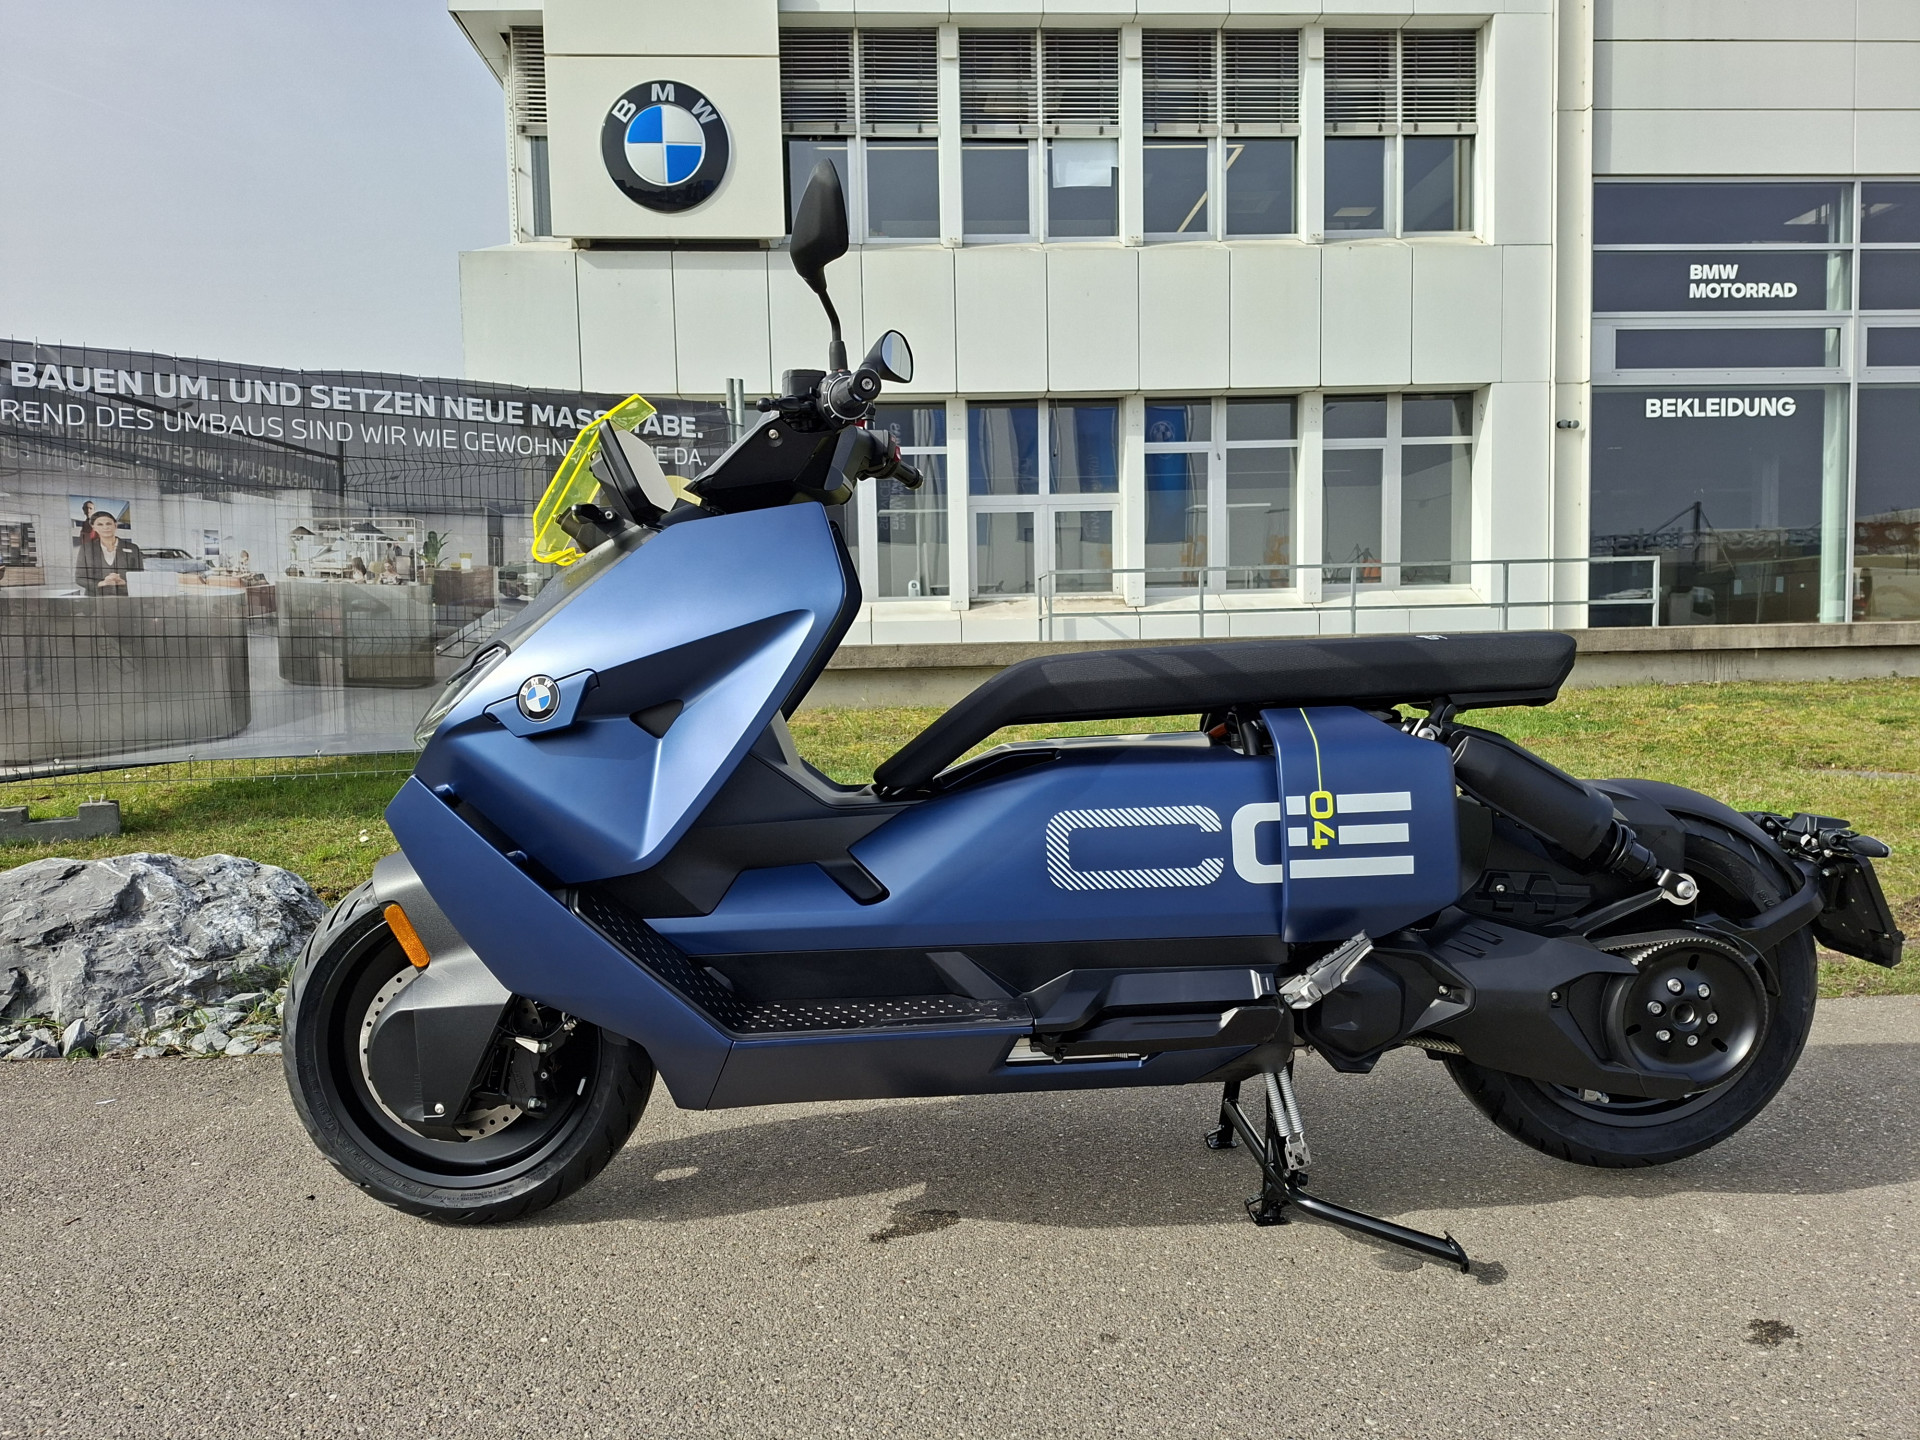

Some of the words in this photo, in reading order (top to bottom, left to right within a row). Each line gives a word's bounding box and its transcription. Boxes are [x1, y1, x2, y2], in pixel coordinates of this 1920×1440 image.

[611, 83, 718, 125] BMW
[1689, 264, 1739, 280] BMW
[1689, 282, 1798, 298] MOTORRAD
[11, 361, 143, 396] BAUEN
[153, 372, 219, 400] UM.
[229, 377, 301, 407] UND
[310, 385, 436, 417] SETZEN
[443, 396, 525, 425] NEUE
[1645, 396, 1797, 418] BEKLEIDUNG
[96, 406, 154, 430] DES
[163, 410, 283, 438] UMBAUS
[291, 418, 354, 442] SIND
[360, 423, 407, 446] WIR
[413, 427, 458, 449] WIE
[674, 447, 707, 467] DA.
[520, 678, 554, 696] BMW
[1309, 790, 1336, 850] 04
